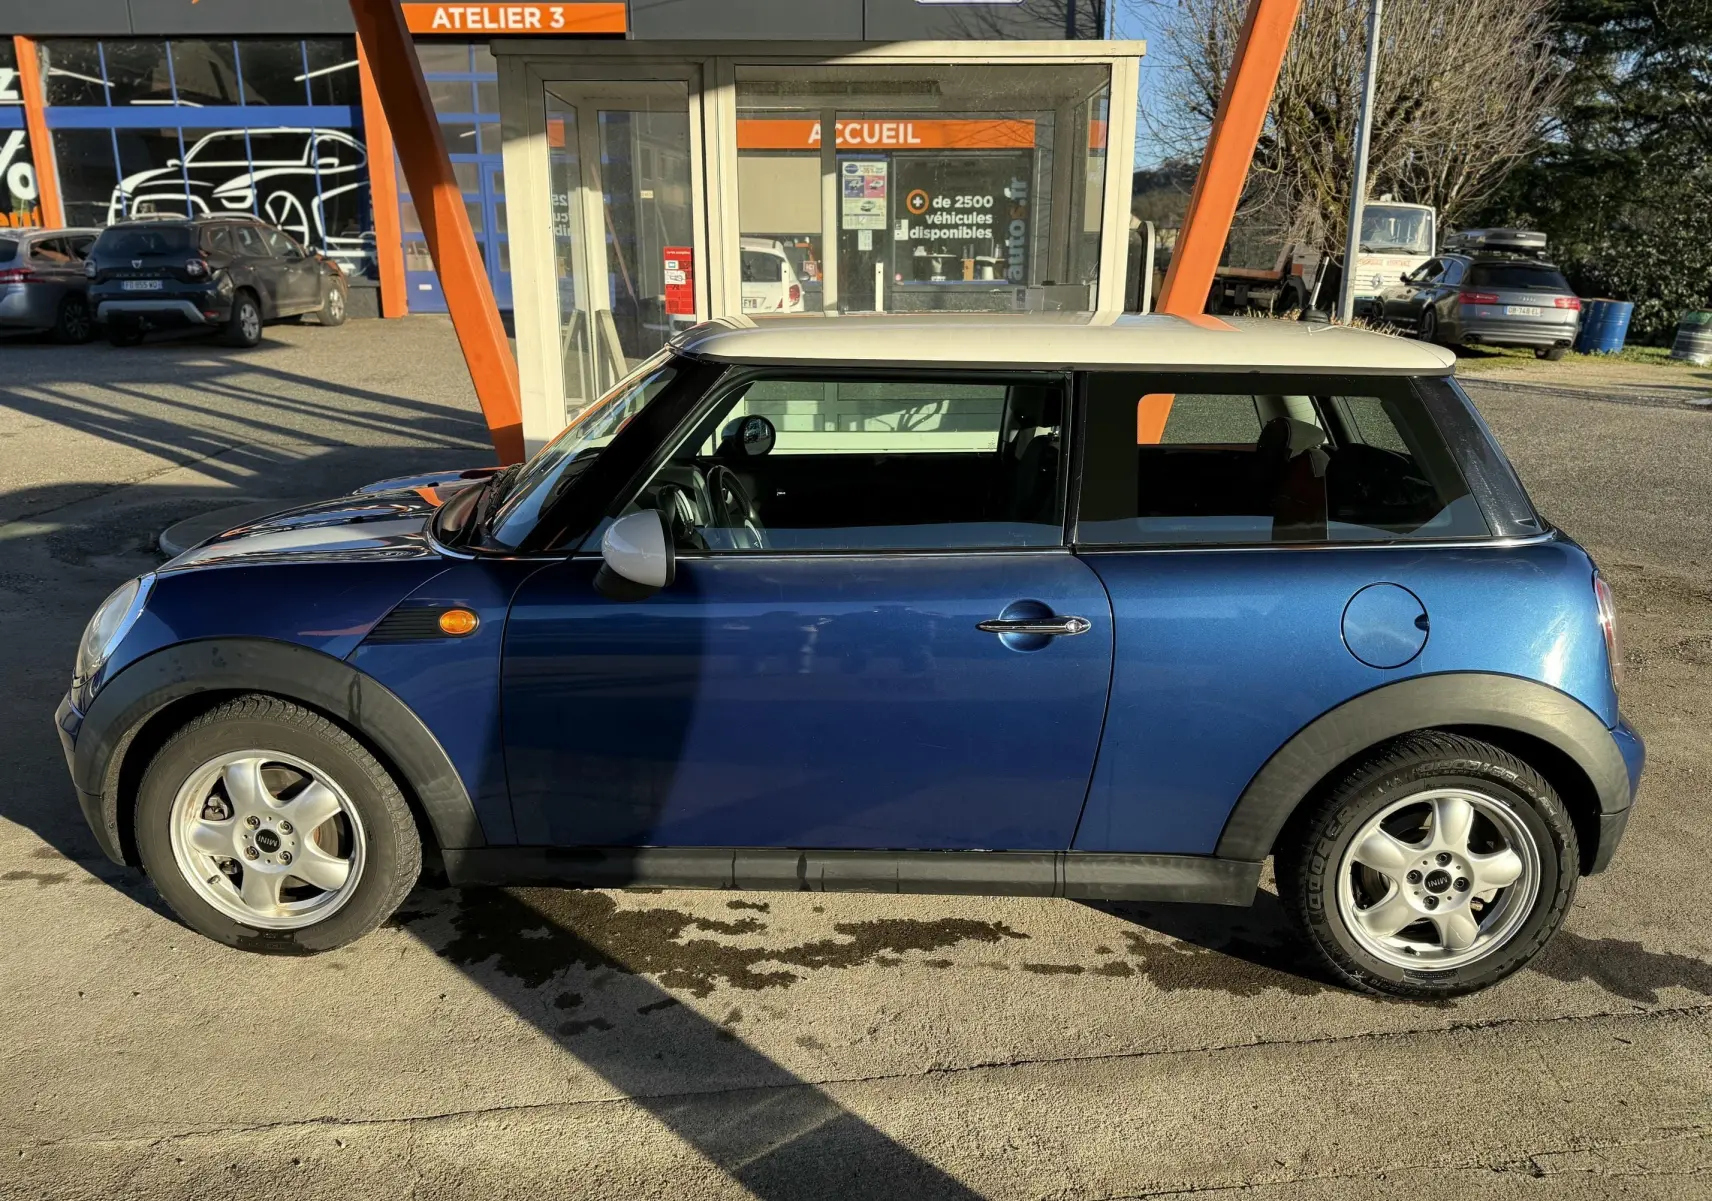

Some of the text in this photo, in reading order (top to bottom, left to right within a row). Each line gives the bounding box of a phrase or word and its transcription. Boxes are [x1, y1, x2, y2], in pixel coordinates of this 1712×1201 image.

[431, 7, 565, 29] ATELIER 3
[932, 195, 952, 208] de
[954, 195, 994, 208] 2500
[925, 211, 993, 225] véhicules
[909, 226, 993, 240] disponibles
[257, 835, 278, 847] MINI
[1427, 876, 1448, 888] MINI
